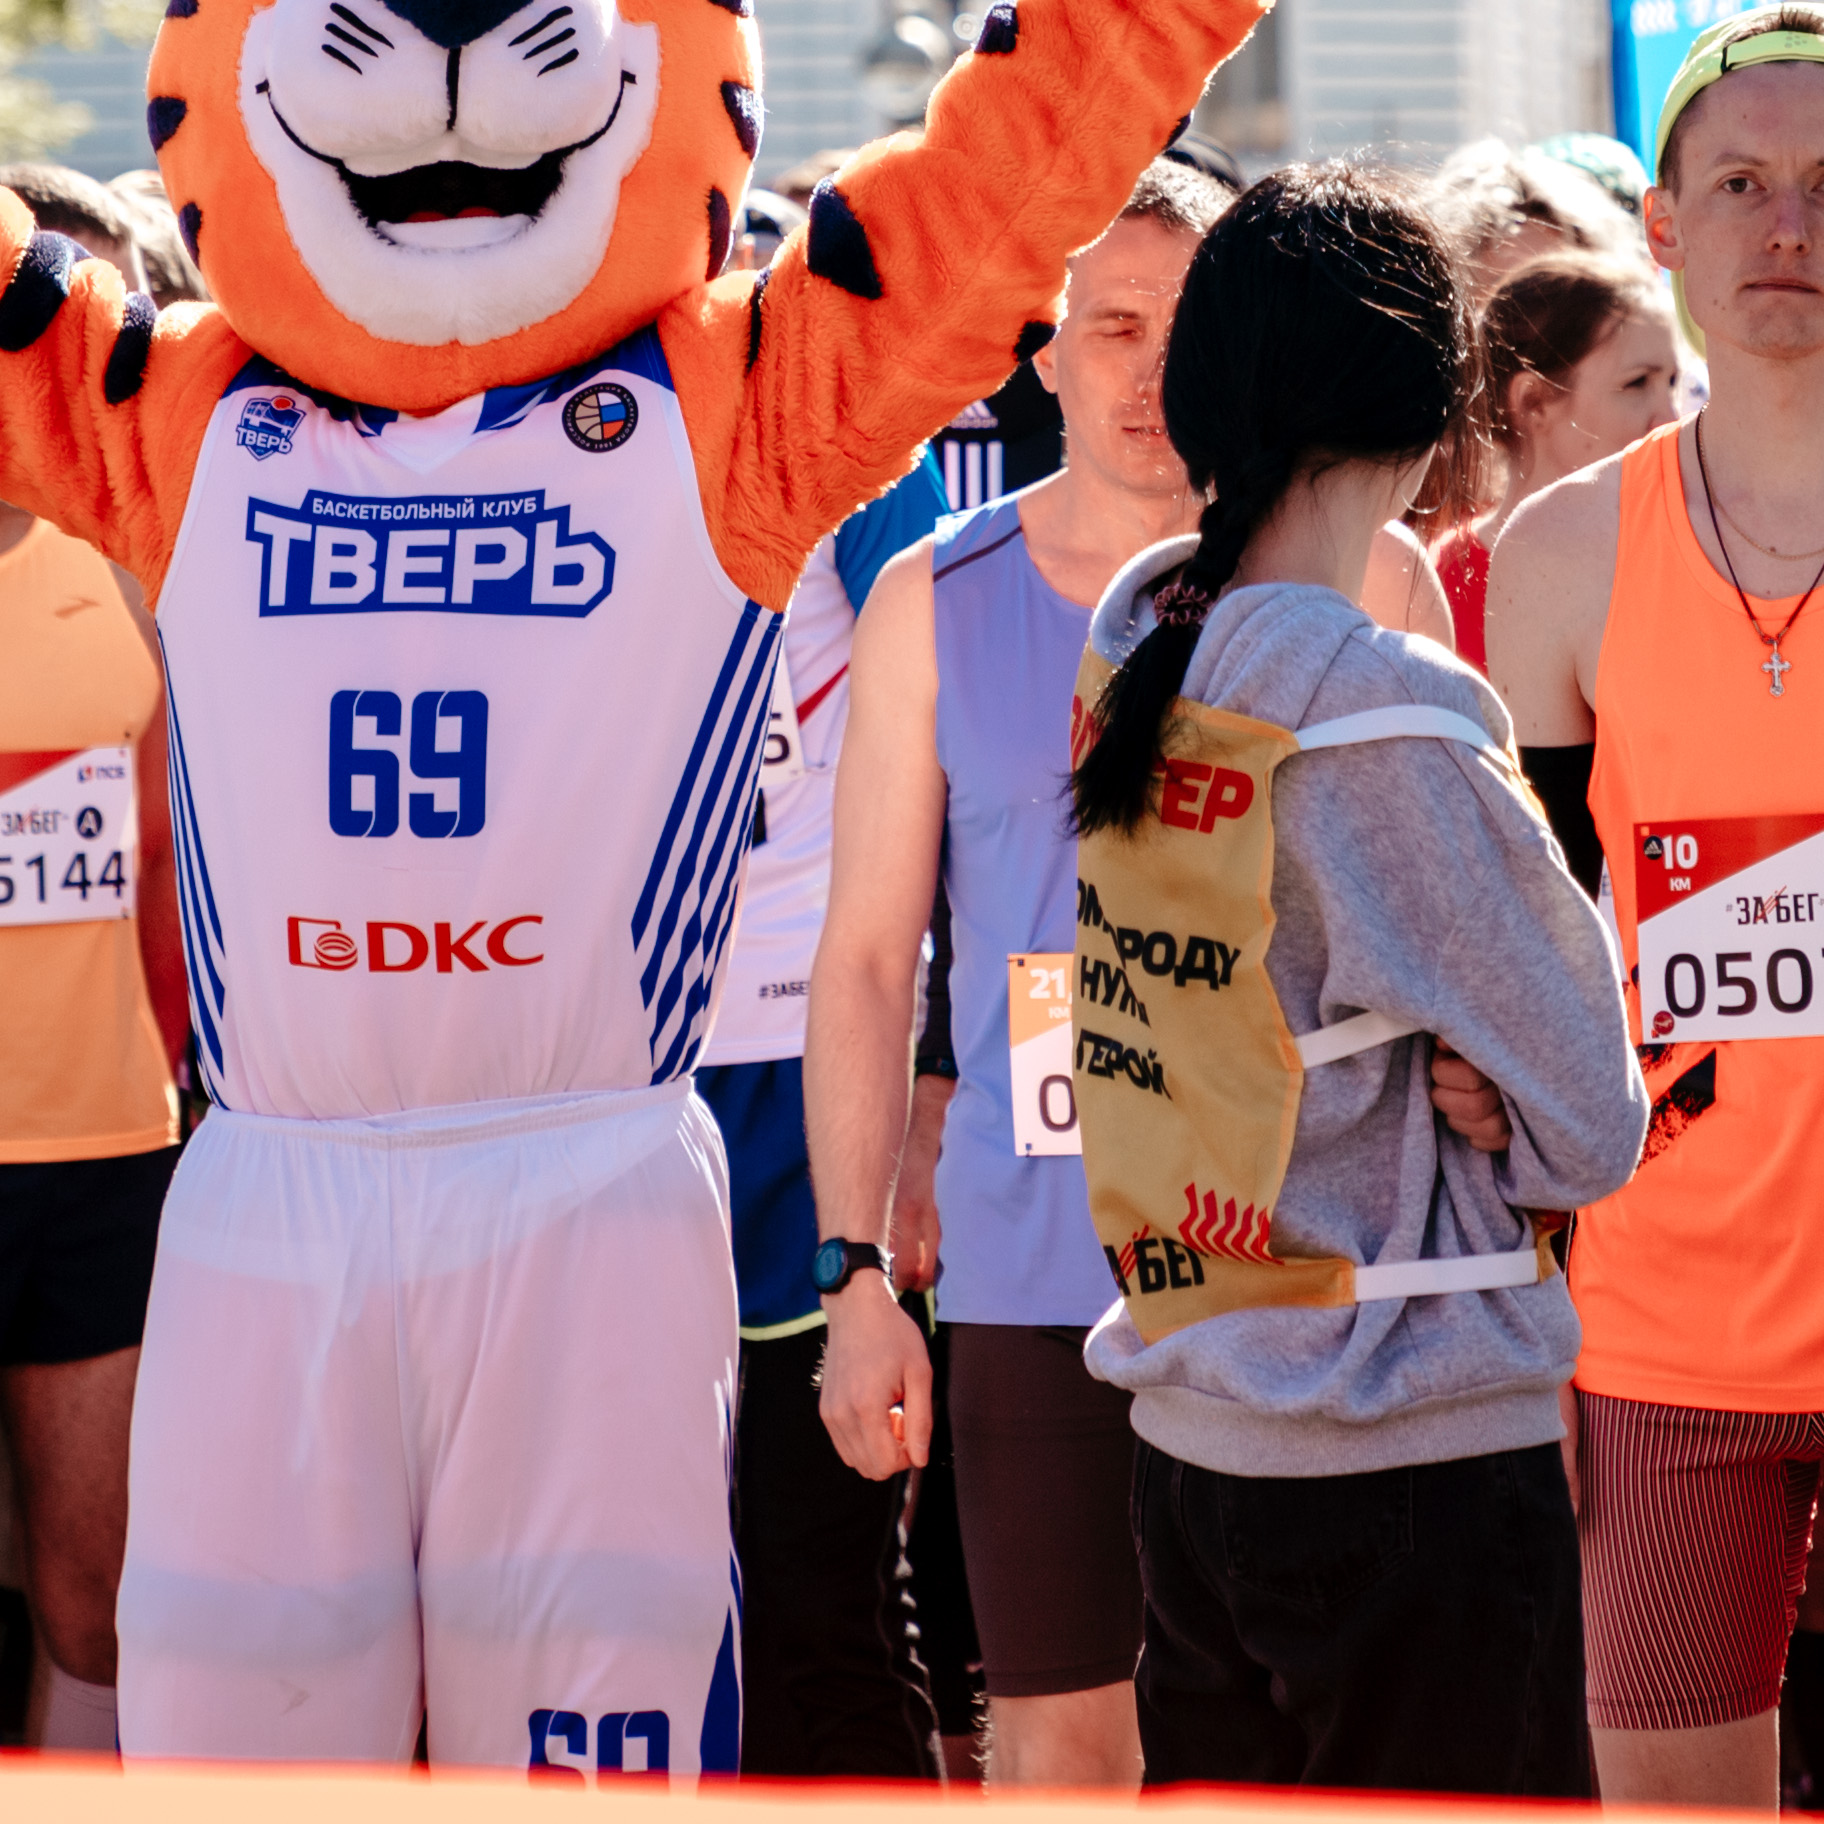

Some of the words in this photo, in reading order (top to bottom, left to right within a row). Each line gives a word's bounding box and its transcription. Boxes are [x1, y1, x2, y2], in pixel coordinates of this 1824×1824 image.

[236, 425, 293, 454] ТВЕРЬ
[312, 496, 476, 521] БАСКЕТБОЛЬНЫЙ
[481, 496, 537, 519] КЛУБ
[253, 509, 607, 607] ТВЕРЬ
[328, 689, 490, 839] 69
[1663, 834, 1698, 870] 10
[1669, 877, 1692, 892] КМ
[365, 914, 545, 973] DKC
[1077, 1028, 1173, 1102] ГЕРОЙ
